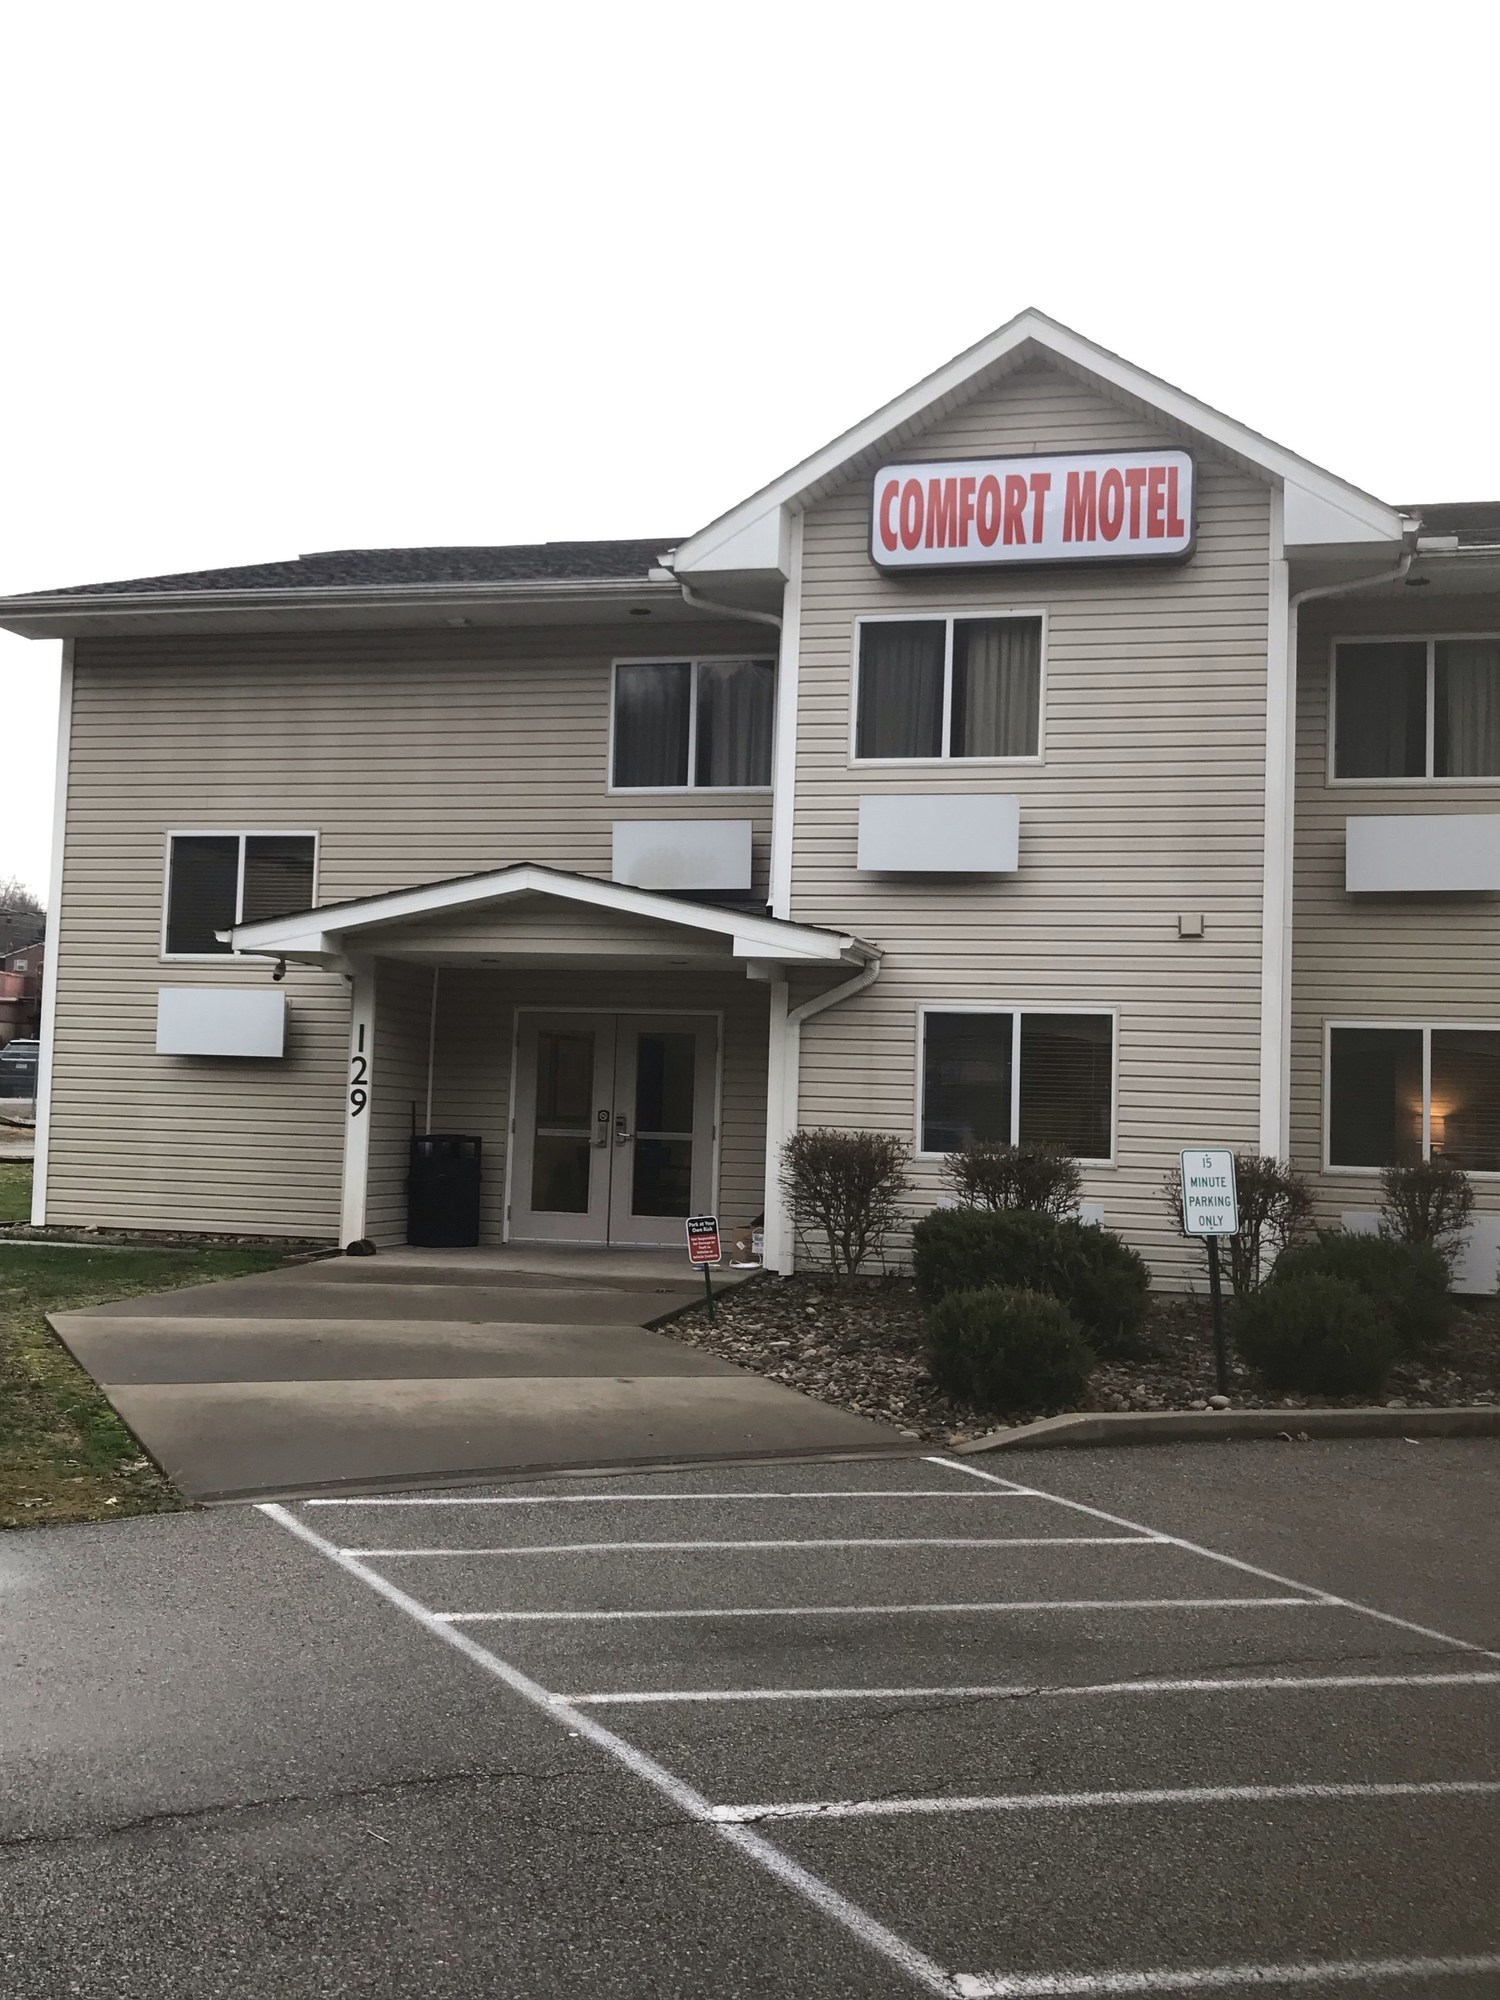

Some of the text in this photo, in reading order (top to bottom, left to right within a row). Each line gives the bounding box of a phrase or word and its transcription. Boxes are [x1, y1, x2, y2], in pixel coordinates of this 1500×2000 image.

[879, 466, 1185, 552] COMFORT MOTEL
[350, 1023, 368, 1117] 129
[1202, 1157, 1212, 1168] 15
[1190, 1177, 1227, 1188] MINUTE
[1189, 1196, 1231, 1207] PARKING
[1198, 1215, 1223, 1226] ONLY
